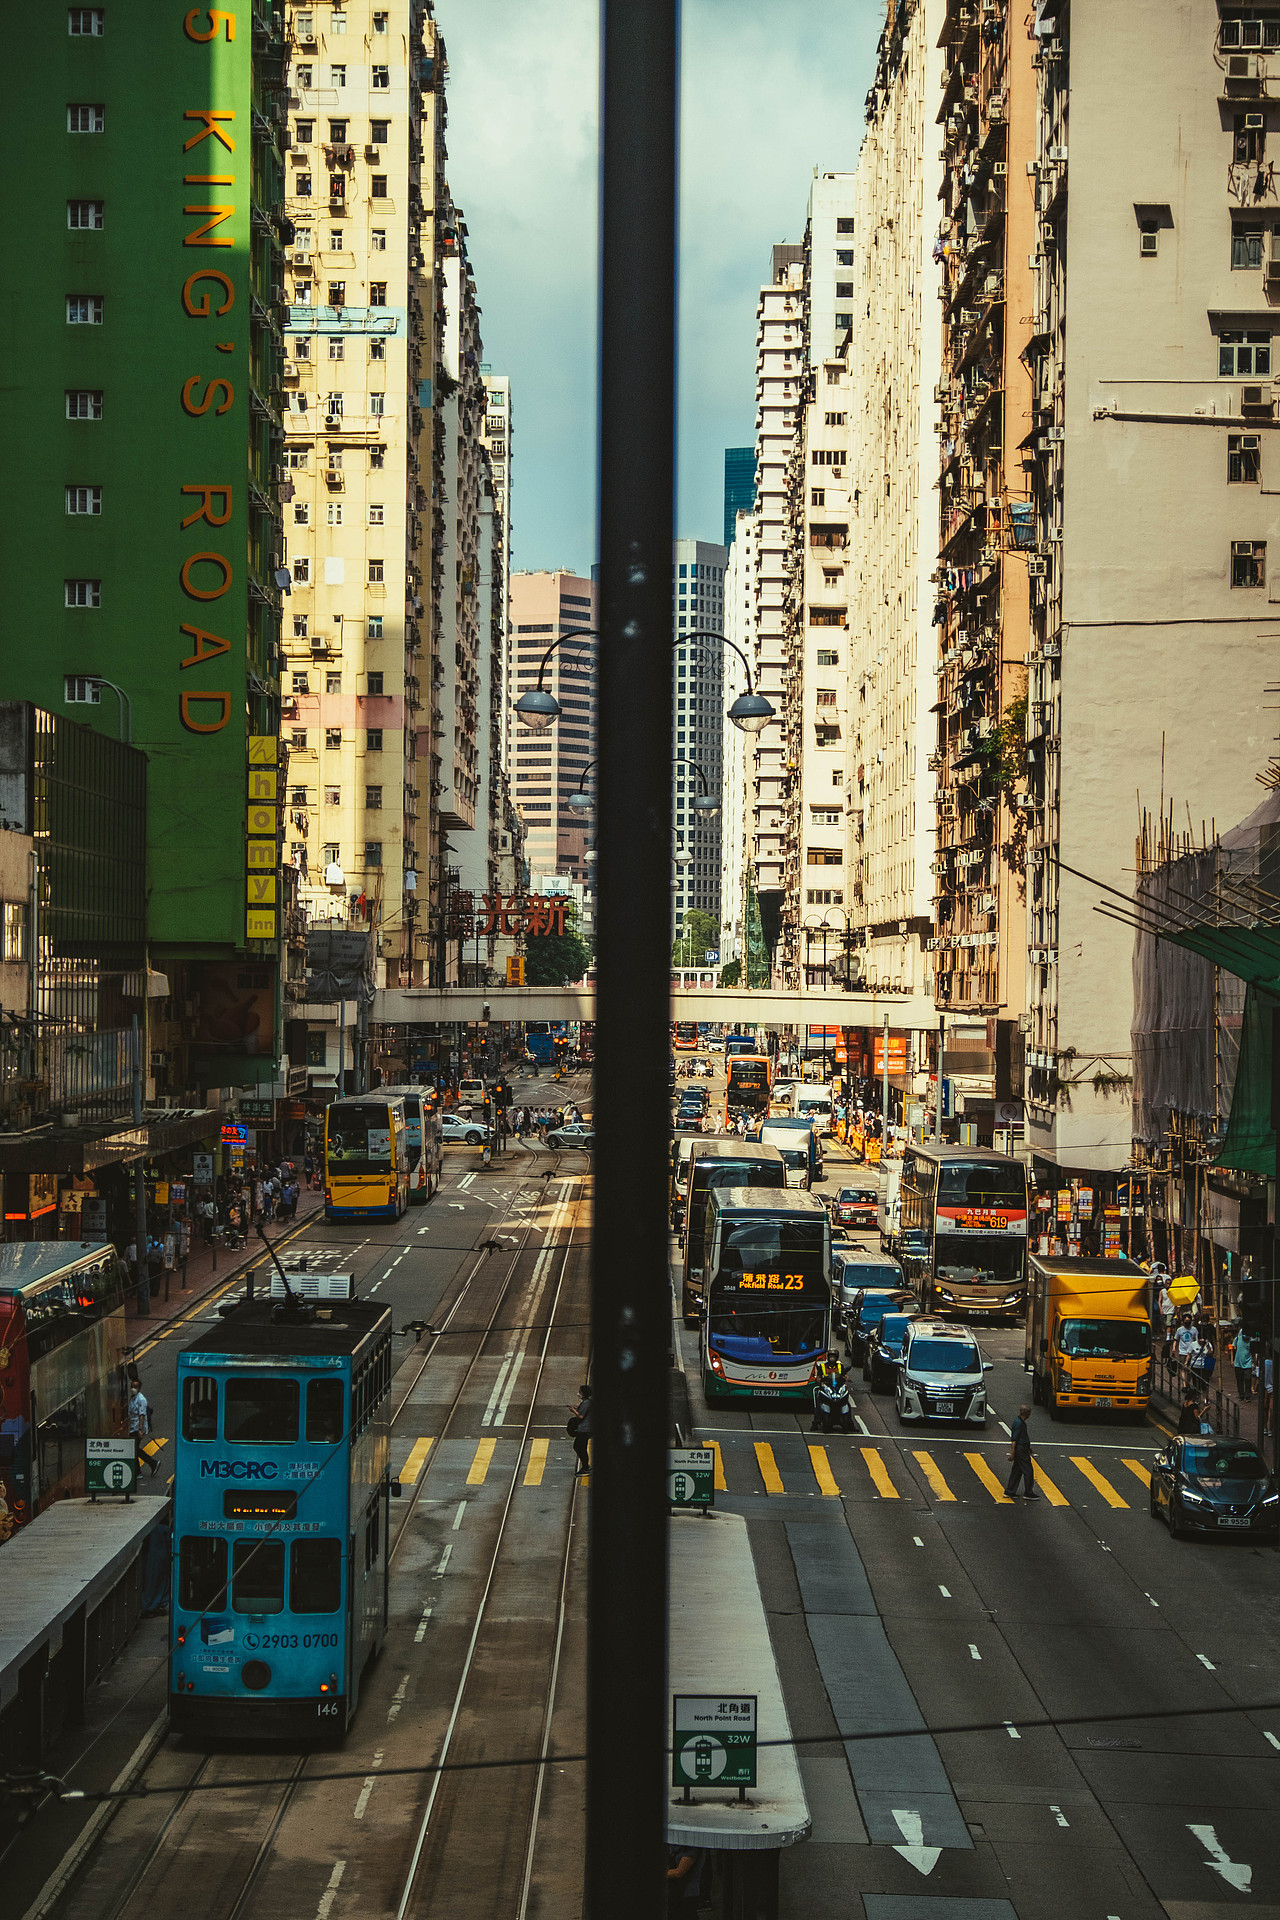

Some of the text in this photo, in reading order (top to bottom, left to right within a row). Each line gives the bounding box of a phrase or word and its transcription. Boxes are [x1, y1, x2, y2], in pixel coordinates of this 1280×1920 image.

[179, 484, 232, 735] ROAD
[248, 917, 274, 930] Inn
[989, 1216, 1007, 1228] 619
[767, 1282, 784, 1290] Road
[784, 1274, 804, 1291] 23
[262, 1634, 338, 1648] 2903 0700
[317, 1703, 338, 1716] 146
[717, 1703, 750, 1714] 北角道
[727, 1735, 751, 1744] 32W
